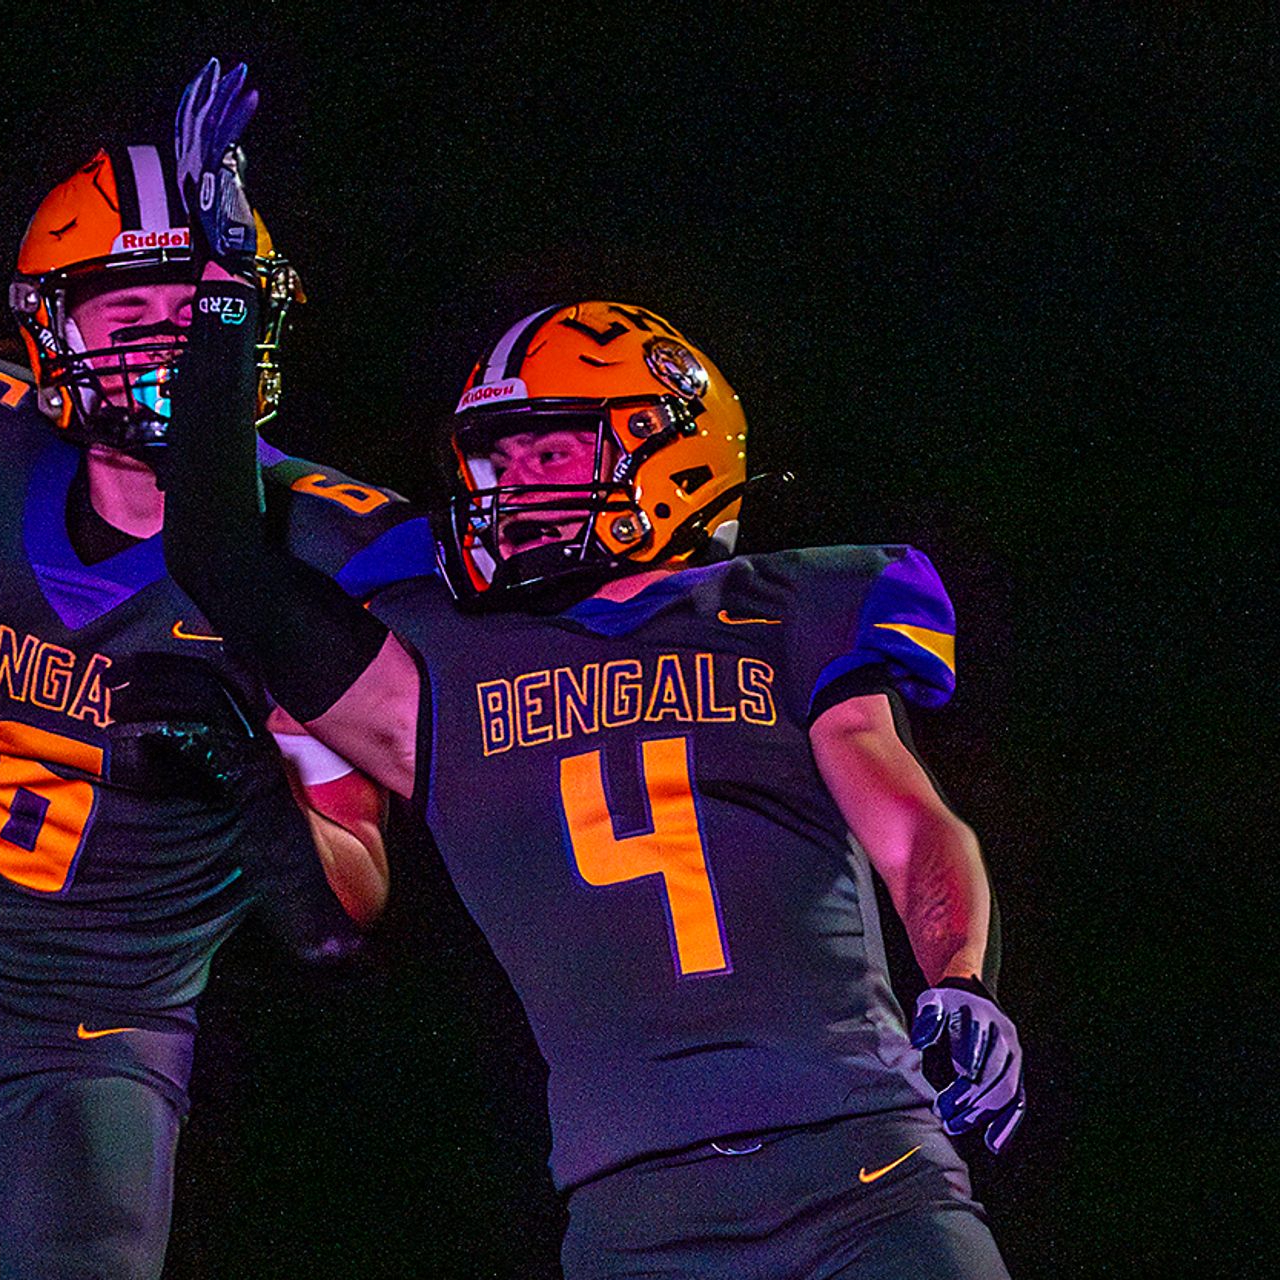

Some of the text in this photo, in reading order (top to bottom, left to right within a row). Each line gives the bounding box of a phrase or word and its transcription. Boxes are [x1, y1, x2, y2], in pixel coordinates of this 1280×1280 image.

[198, 296, 245, 314] LZRD
[476, 652, 777, 756] BENGALS
[558, 735, 732, 977] 4
